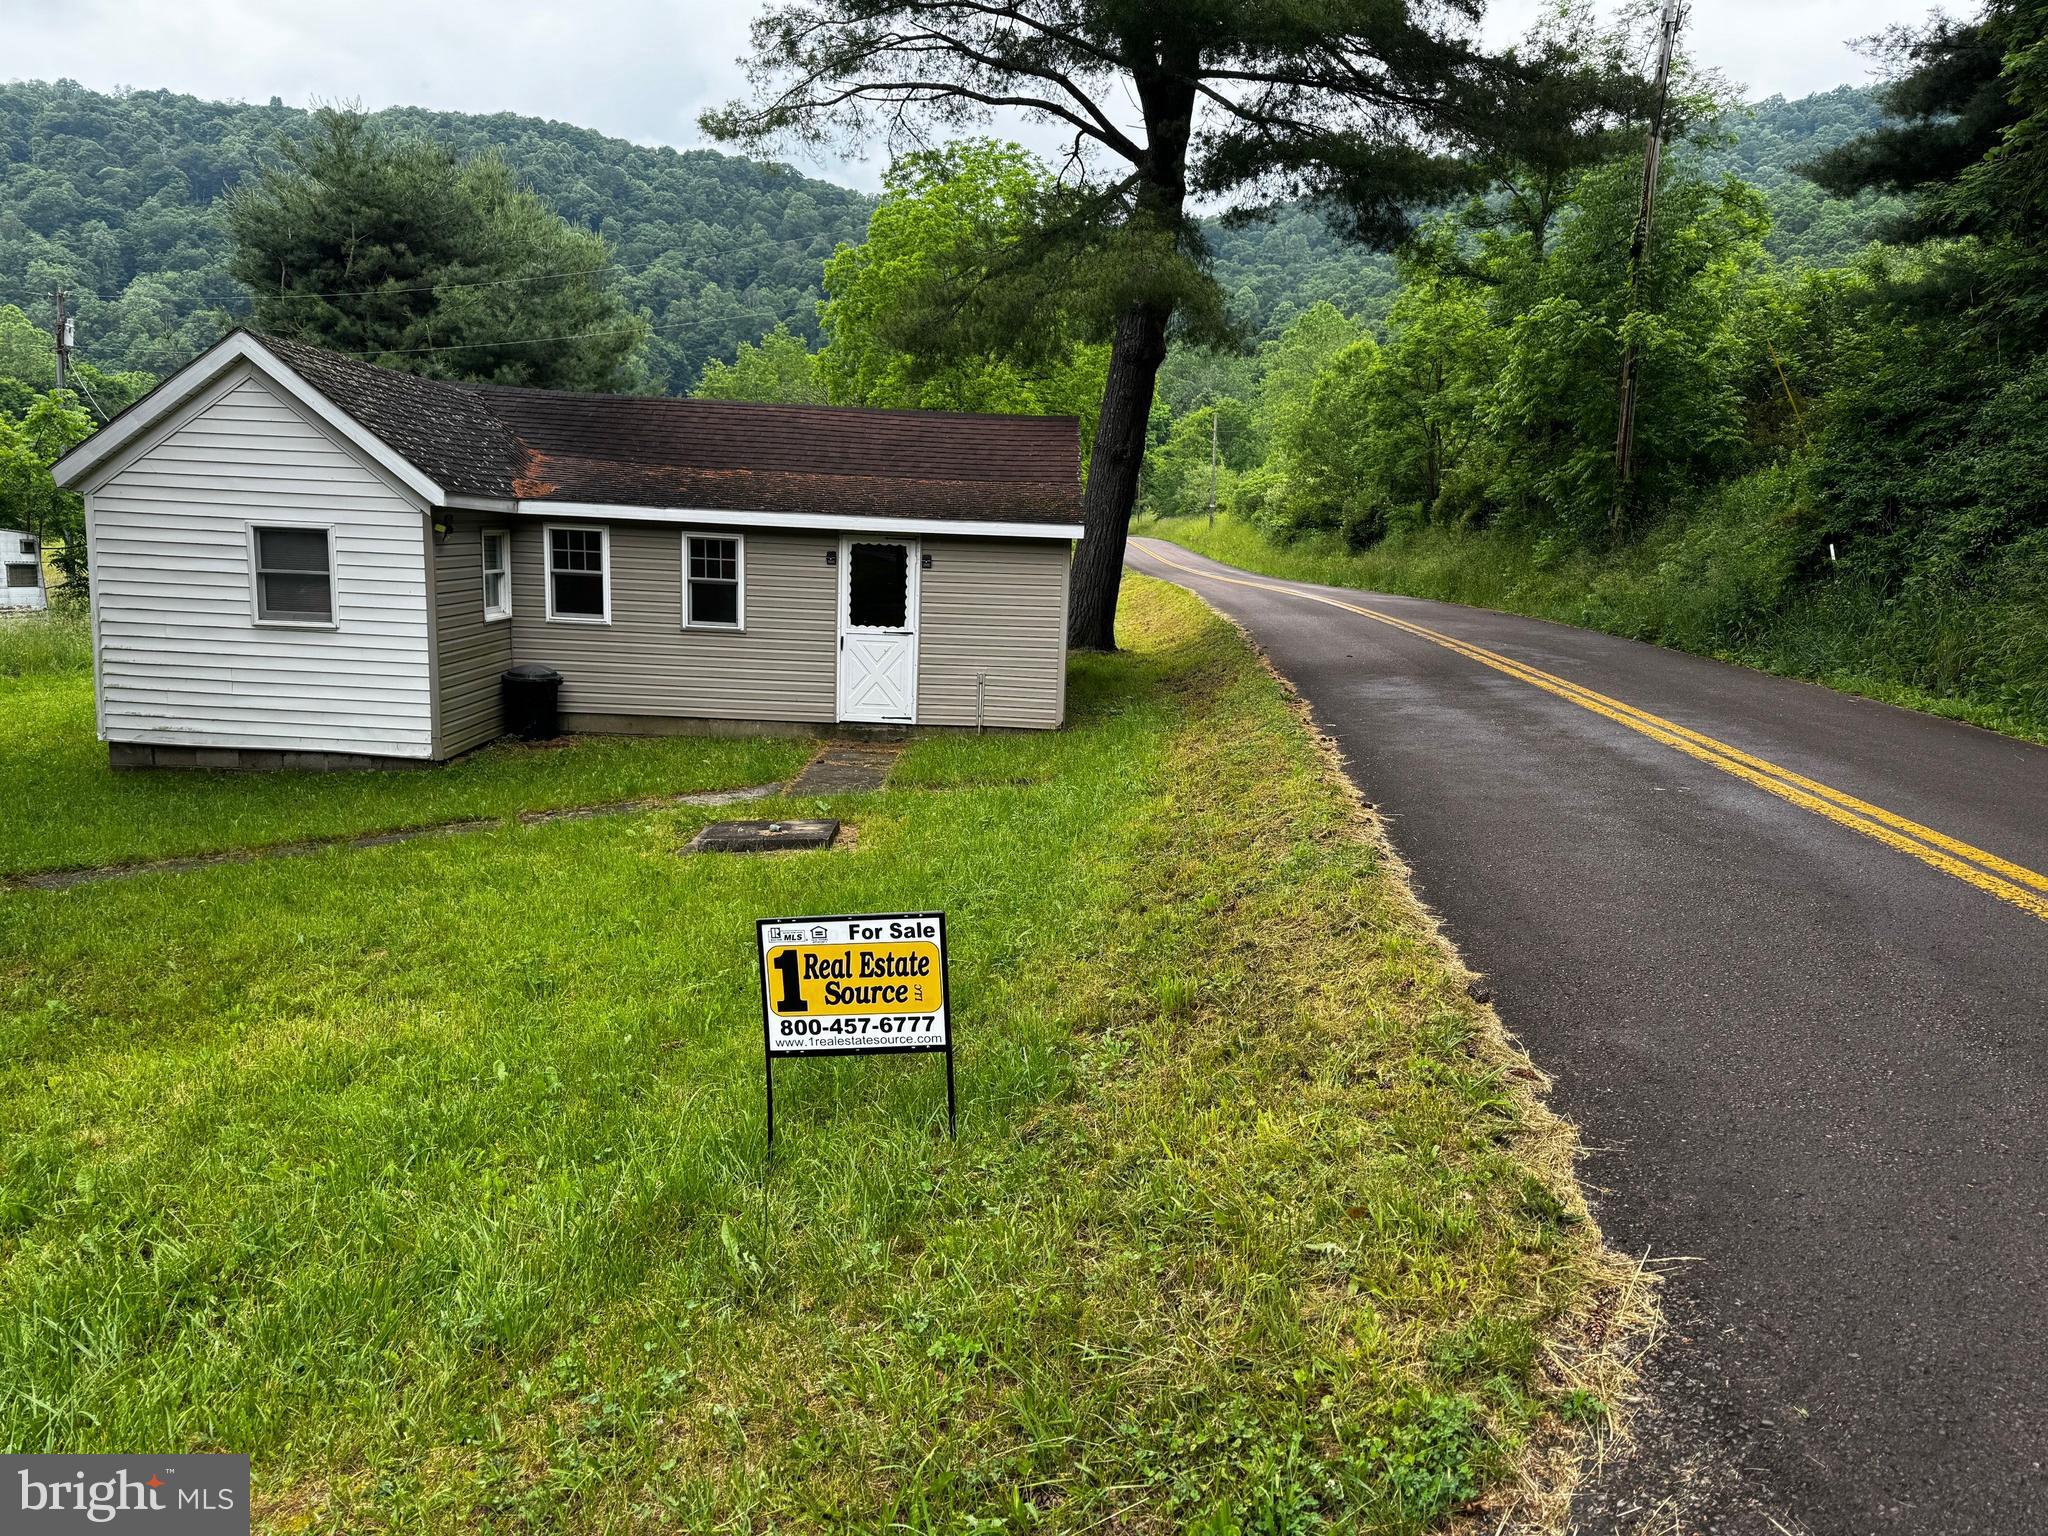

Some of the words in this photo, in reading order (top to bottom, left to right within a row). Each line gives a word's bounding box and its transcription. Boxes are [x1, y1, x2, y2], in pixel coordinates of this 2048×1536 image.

[784, 933, 803, 941] MLS
[848, 923, 883, 940] For
[889, 922, 936, 938] Sale
[773, 949, 809, 1012] 1
[803, 950, 853, 980] Real
[859, 950, 930, 979] Estate
[824, 980, 909, 1006] Source
[914, 984, 923, 1002] LLC
[780, 1016, 936, 1036] 800-457-6777
[775, 1035, 942, 1047] www.1realestatesource.com
